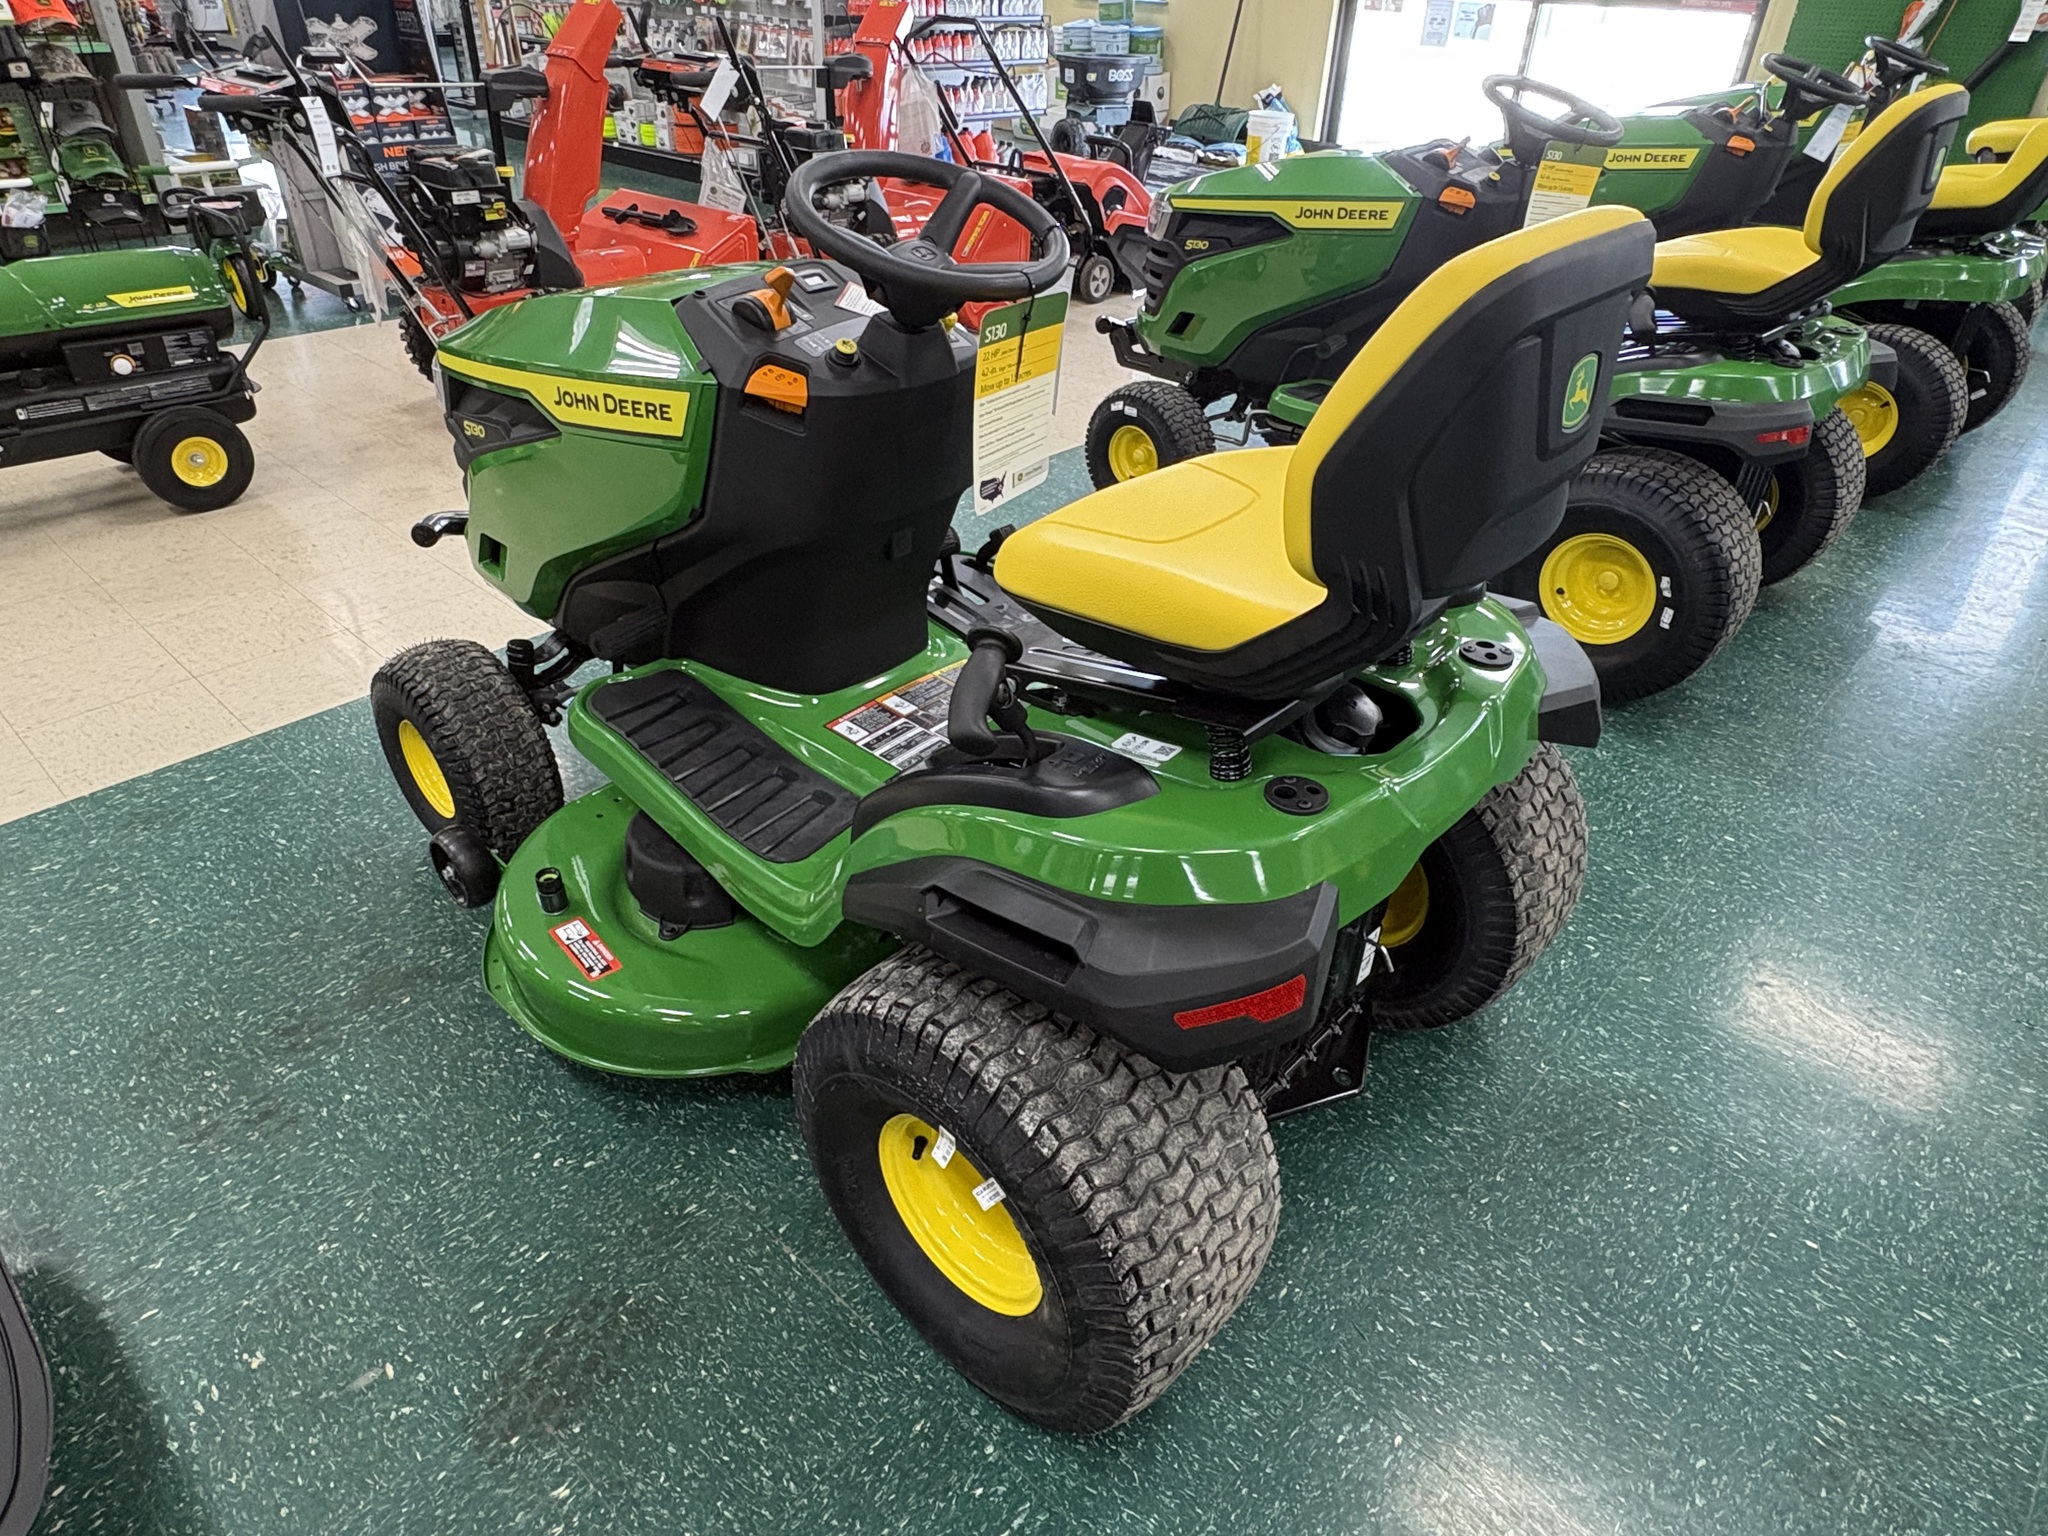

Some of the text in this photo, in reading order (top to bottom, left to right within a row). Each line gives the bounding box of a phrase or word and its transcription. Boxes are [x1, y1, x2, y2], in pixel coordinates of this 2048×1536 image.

[1108, 68, 1134, 82] BOSS
[1545, 150, 1563, 161] S130
[1608, 153, 1687, 163] JOHN DEERE
[374, 161, 388, 172] GH
[1295, 206, 1389, 220] JOHN DEERE
[1184, 239, 1209, 250] S130
[984, 322, 1007, 343] S130
[982, 350, 991, 362] 22
[991, 348, 1001, 359] HP
[995, 379, 1003, 390] up
[1003, 377, 1010, 385] to
[554, 386, 673, 422] JOHN DEERE
[463, 420, 486, 439] S130
